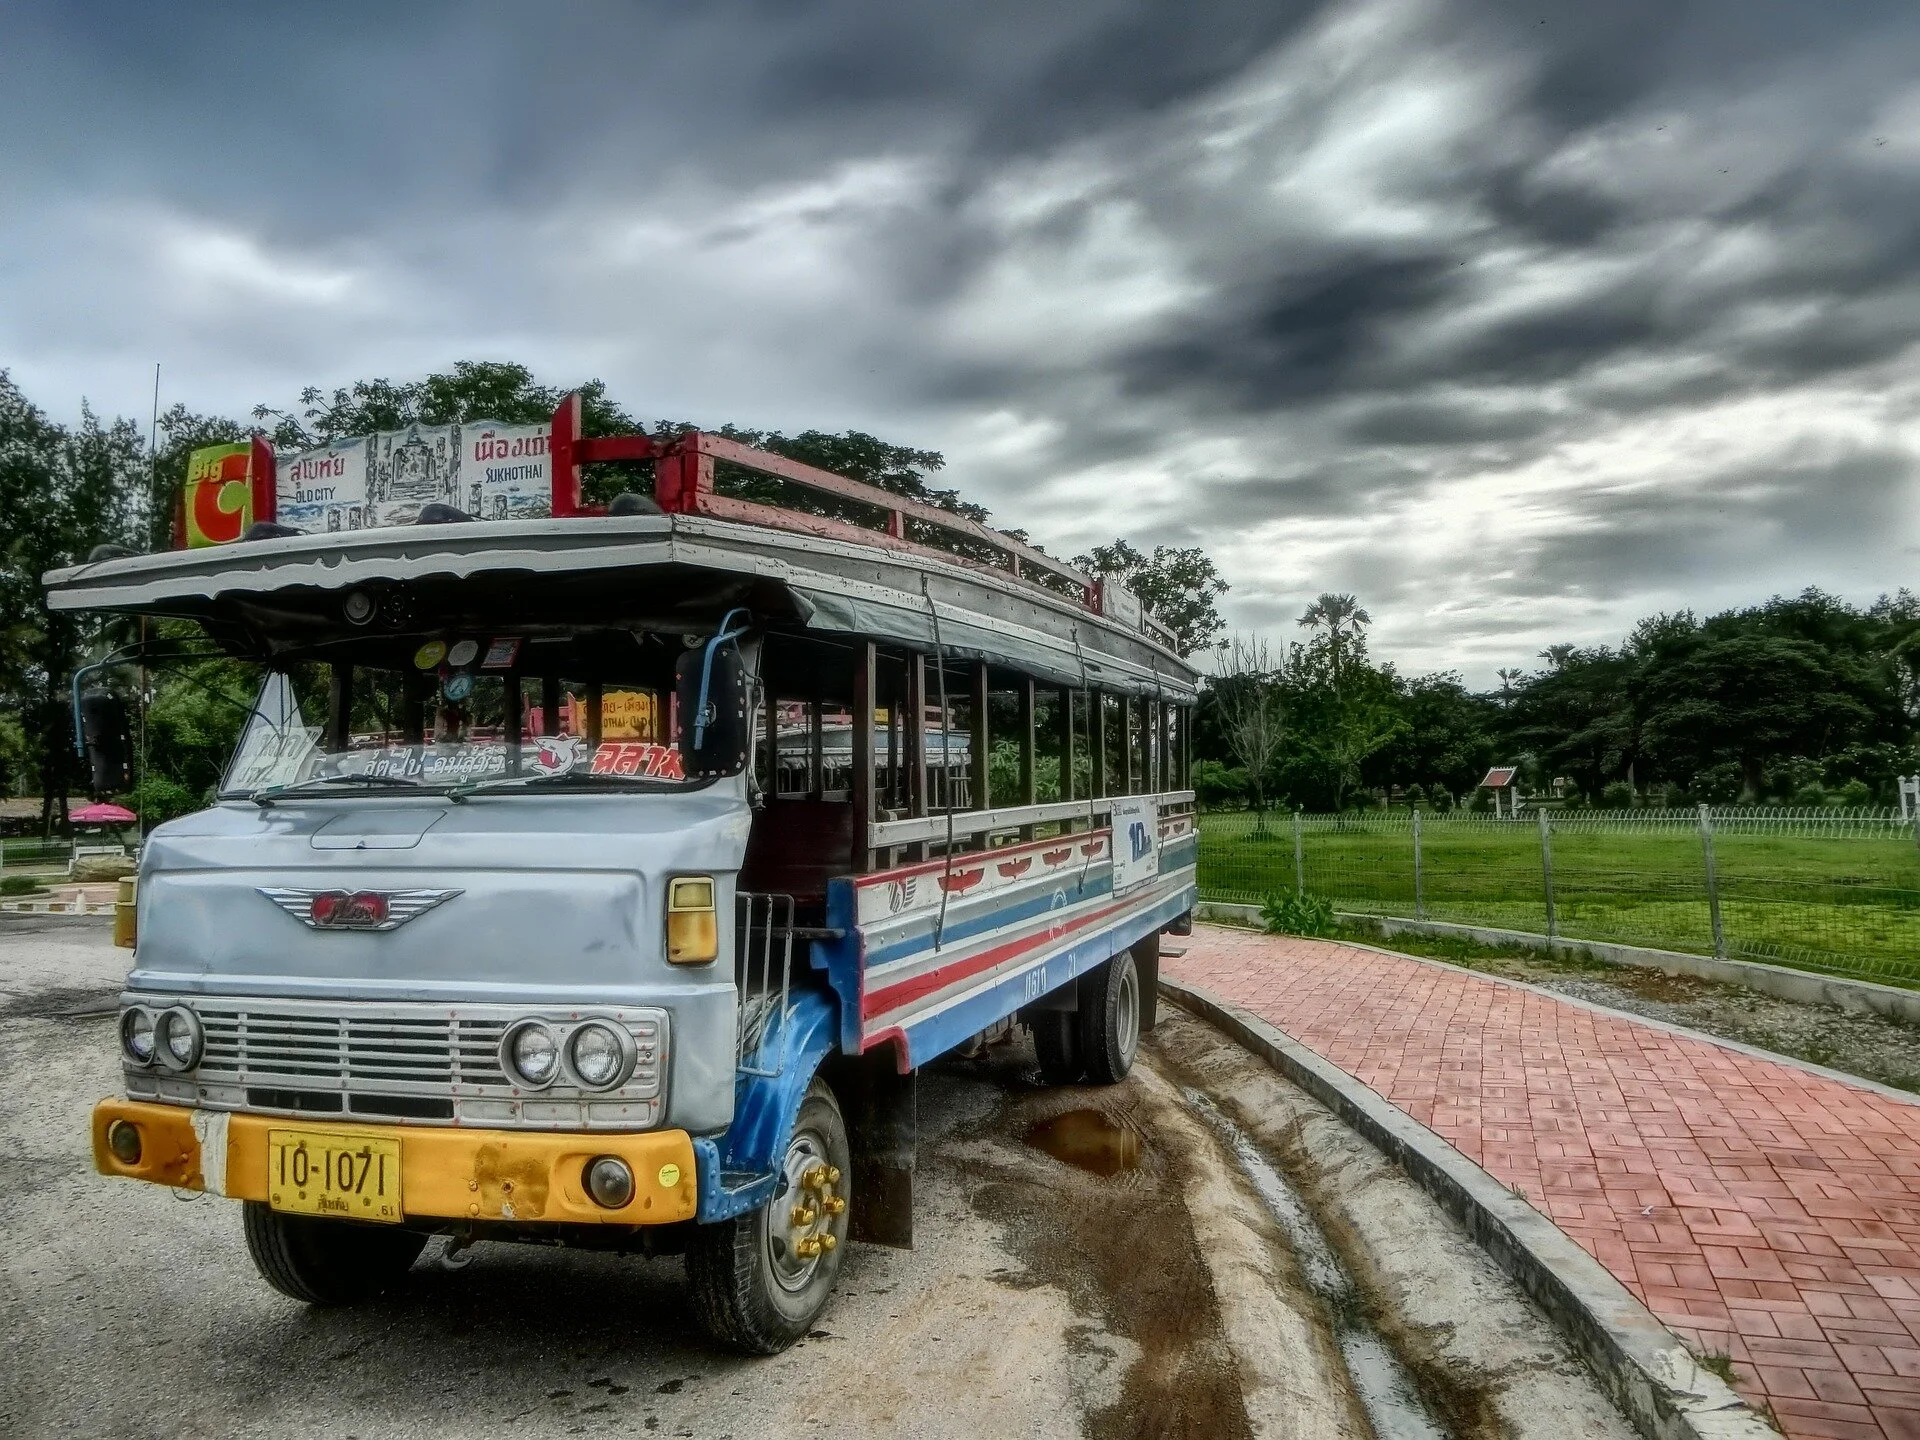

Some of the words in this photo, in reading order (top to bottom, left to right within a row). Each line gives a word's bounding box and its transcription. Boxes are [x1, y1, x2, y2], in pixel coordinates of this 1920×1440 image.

[190, 459, 224, 484] Big
[485, 464, 543, 483] SUKHOTHAI
[295, 489, 314, 503] OLD
[315, 486, 336, 501] CITY
[280, 1145, 385, 1196] 10-1071
